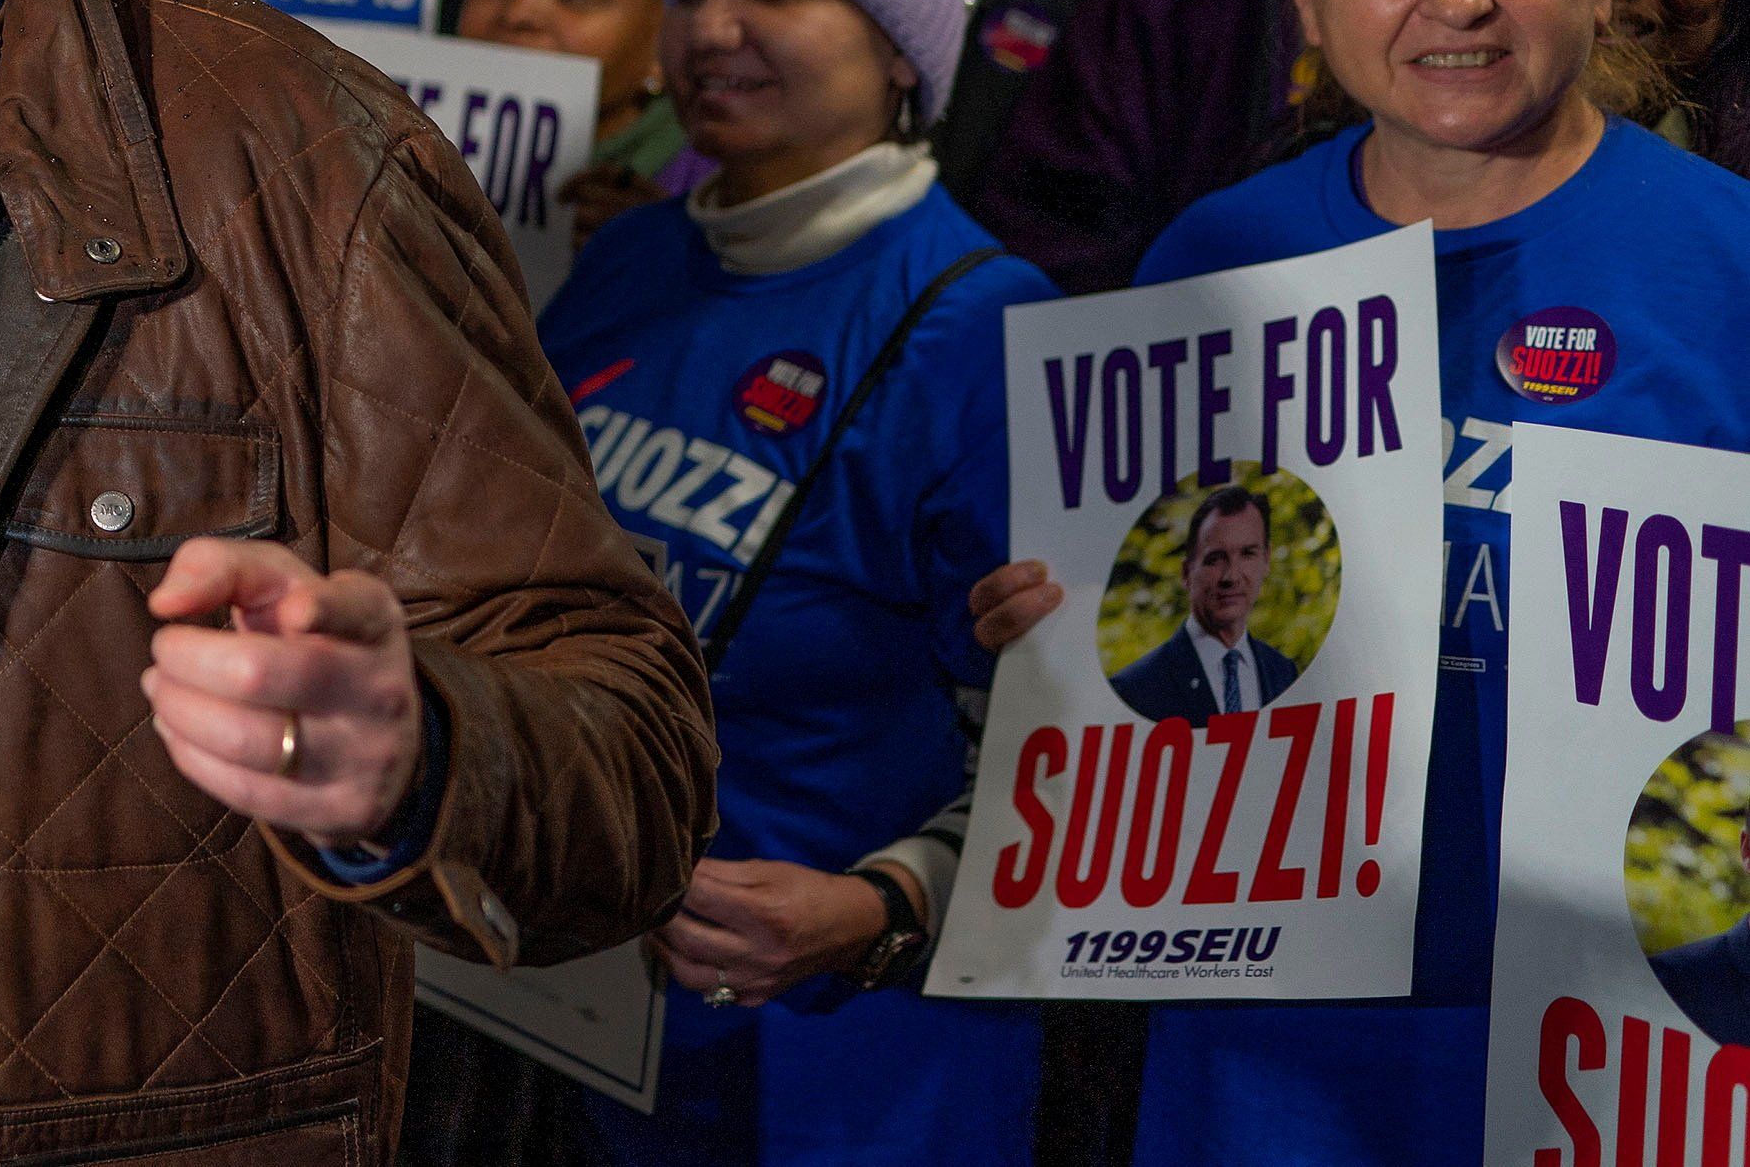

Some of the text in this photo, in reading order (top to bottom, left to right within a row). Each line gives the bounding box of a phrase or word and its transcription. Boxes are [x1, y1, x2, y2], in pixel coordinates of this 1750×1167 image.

[460, 94, 557, 227] FOR
[1525, 325, 1597, 351] VOTE FOR
[1509, 345, 1602, 385] SUOZZI!
[1045, 329, 1232, 511] VOTE
[1261, 294, 1402, 474] FOR
[993, 691, 1396, 909] SUOZZI!
[1065, 926, 1282, 963] 1199SEIU
[1061, 964, 1274, 979] United Healthcare Workers East
